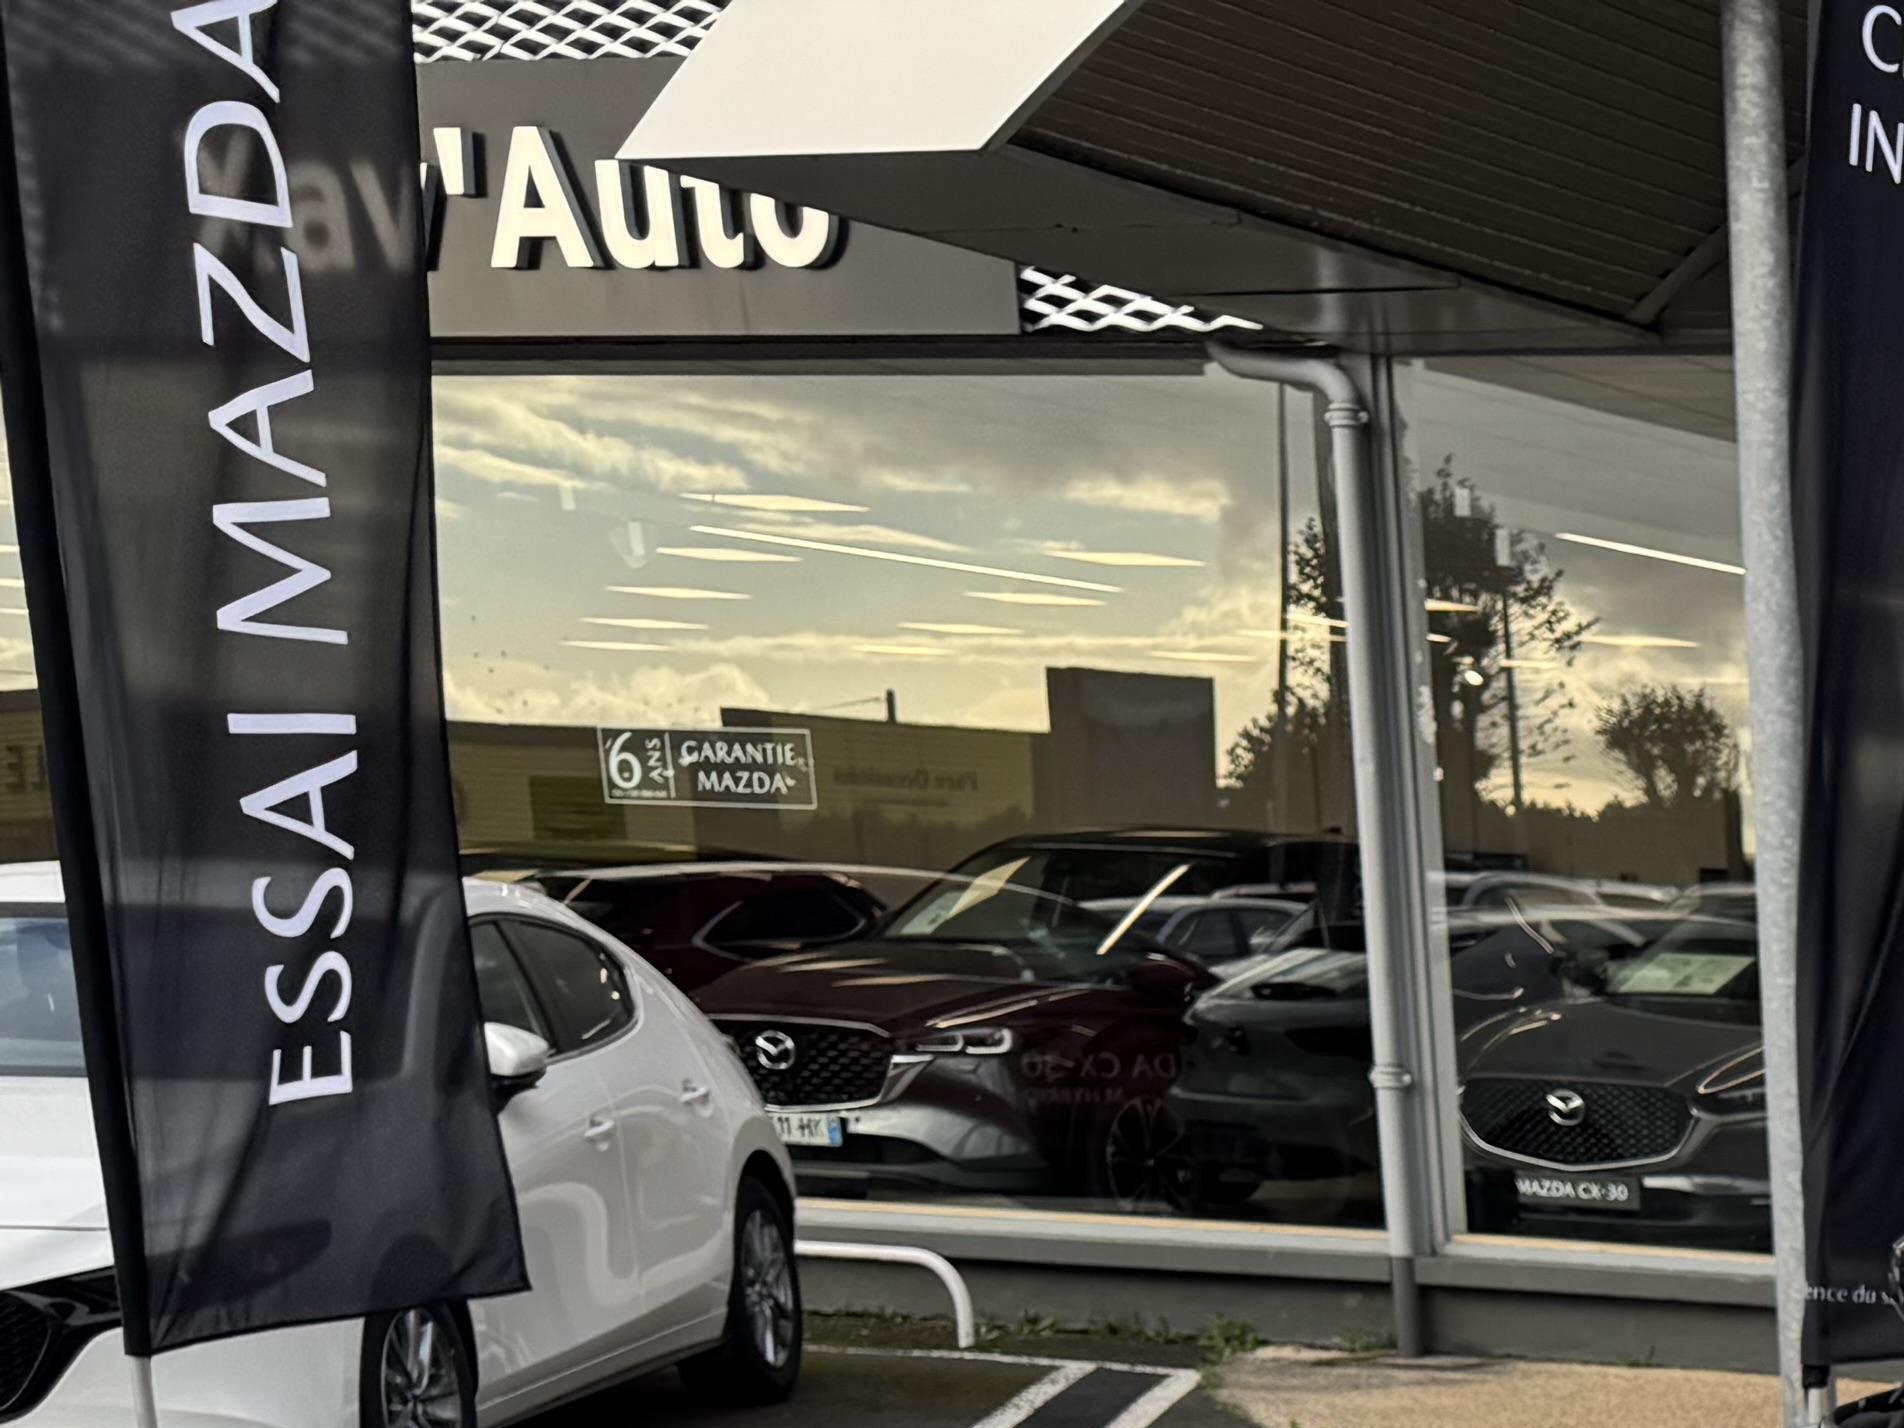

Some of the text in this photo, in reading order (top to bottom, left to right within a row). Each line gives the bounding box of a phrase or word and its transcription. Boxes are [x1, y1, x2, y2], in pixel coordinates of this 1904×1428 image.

[1849, 103, 1904, 184] IN
[172, 0, 358, 1106] ESSAI MAZDA
[608, 731, 674, 789] 6 ANS
[680, 740, 797, 766] GARANTIE
[697, 770, 789, 795] MAZDA
[1515, 1178, 1576, 1199] MAZDA
[1852, 1284, 1876, 1304] du
